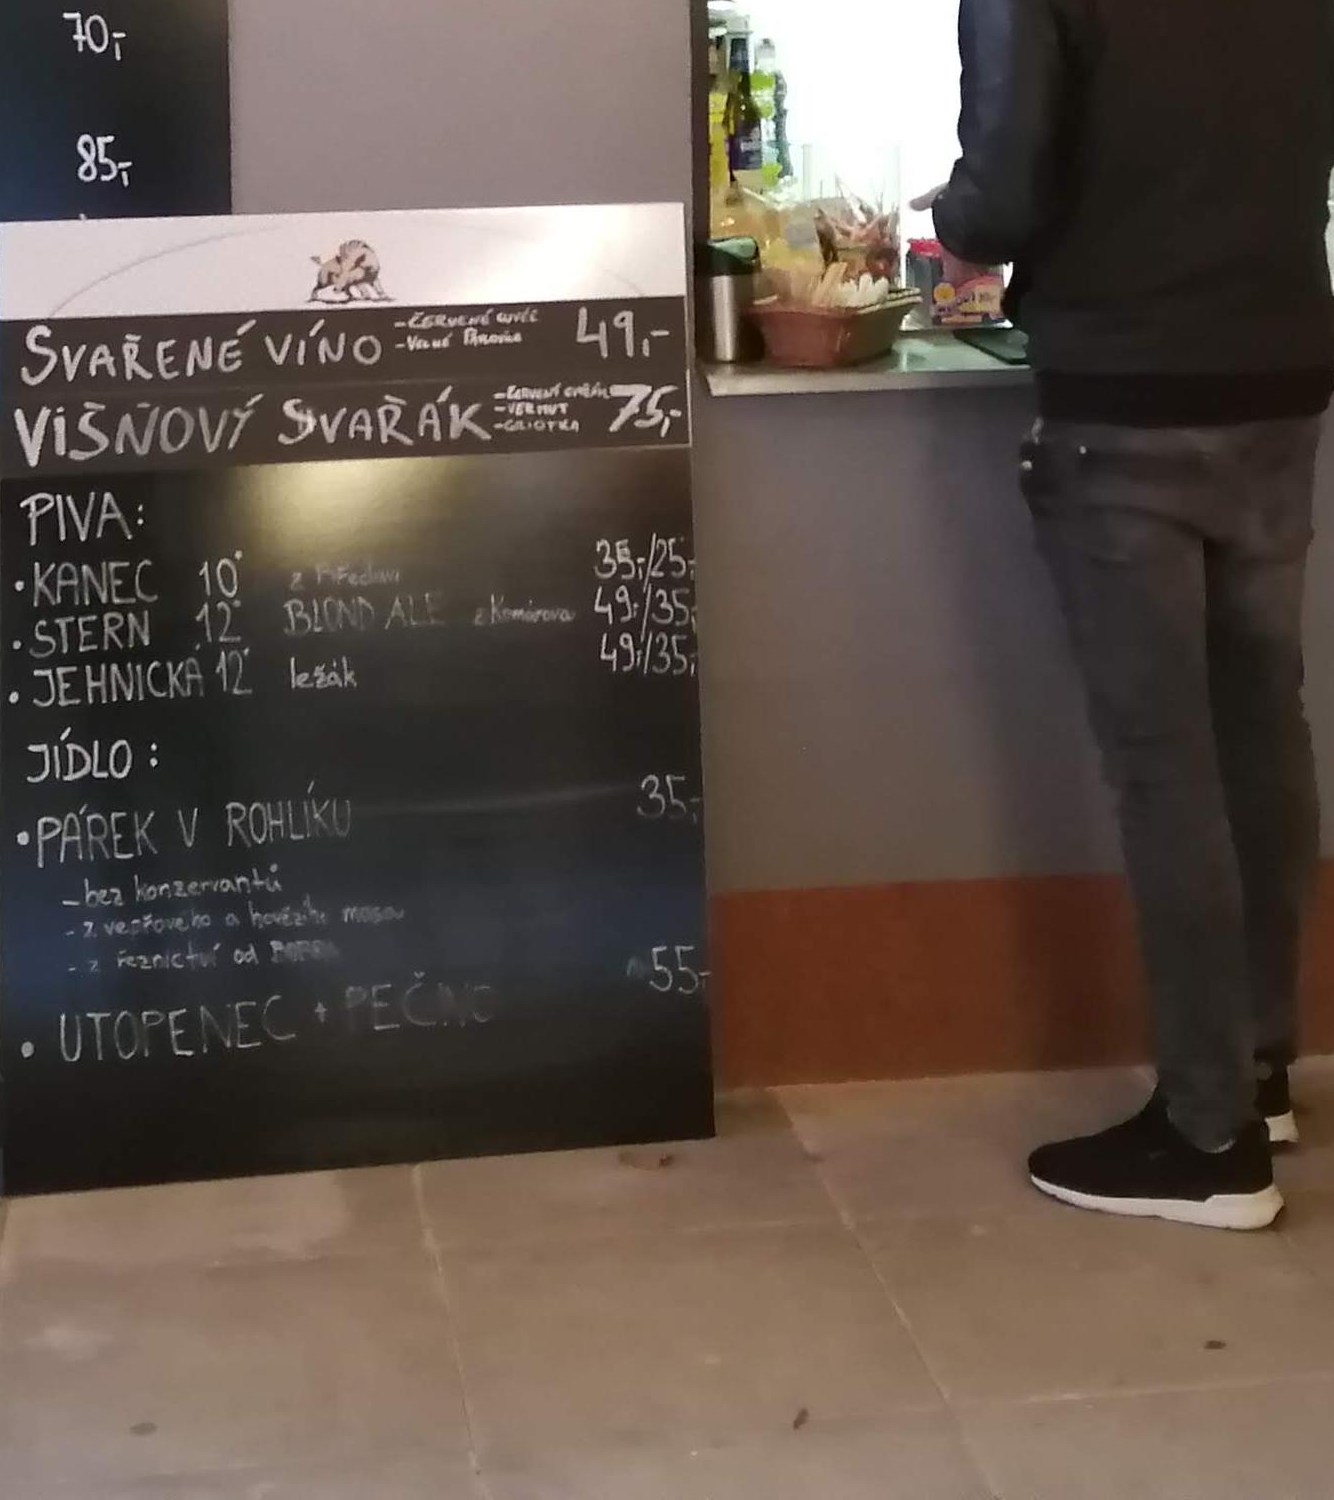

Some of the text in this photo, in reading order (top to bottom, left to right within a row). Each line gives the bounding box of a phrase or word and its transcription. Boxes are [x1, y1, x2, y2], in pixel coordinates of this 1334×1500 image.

[20, 320, 258, 387] SVAŘENÉ
[266, 319, 382, 368] VÍNO
[13, 393, 265, 467] VIŠŇOVÝ
[277, 386, 492, 445] SVAŘÁK
[19, 492, 146, 545] PIVA:
[32, 559, 159, 606] KANEC
[30, 613, 151, 657] STERN
[32, 643, 205, 708] JEHNICKÁ
[289, 655, 358, 690] ležák
[37, 805, 158, 869] PÁREK
[227, 780, 353, 848] ROHLÍKU
[233, 943, 259, 966] od
[59, 994, 297, 1062] UTOPENEC
